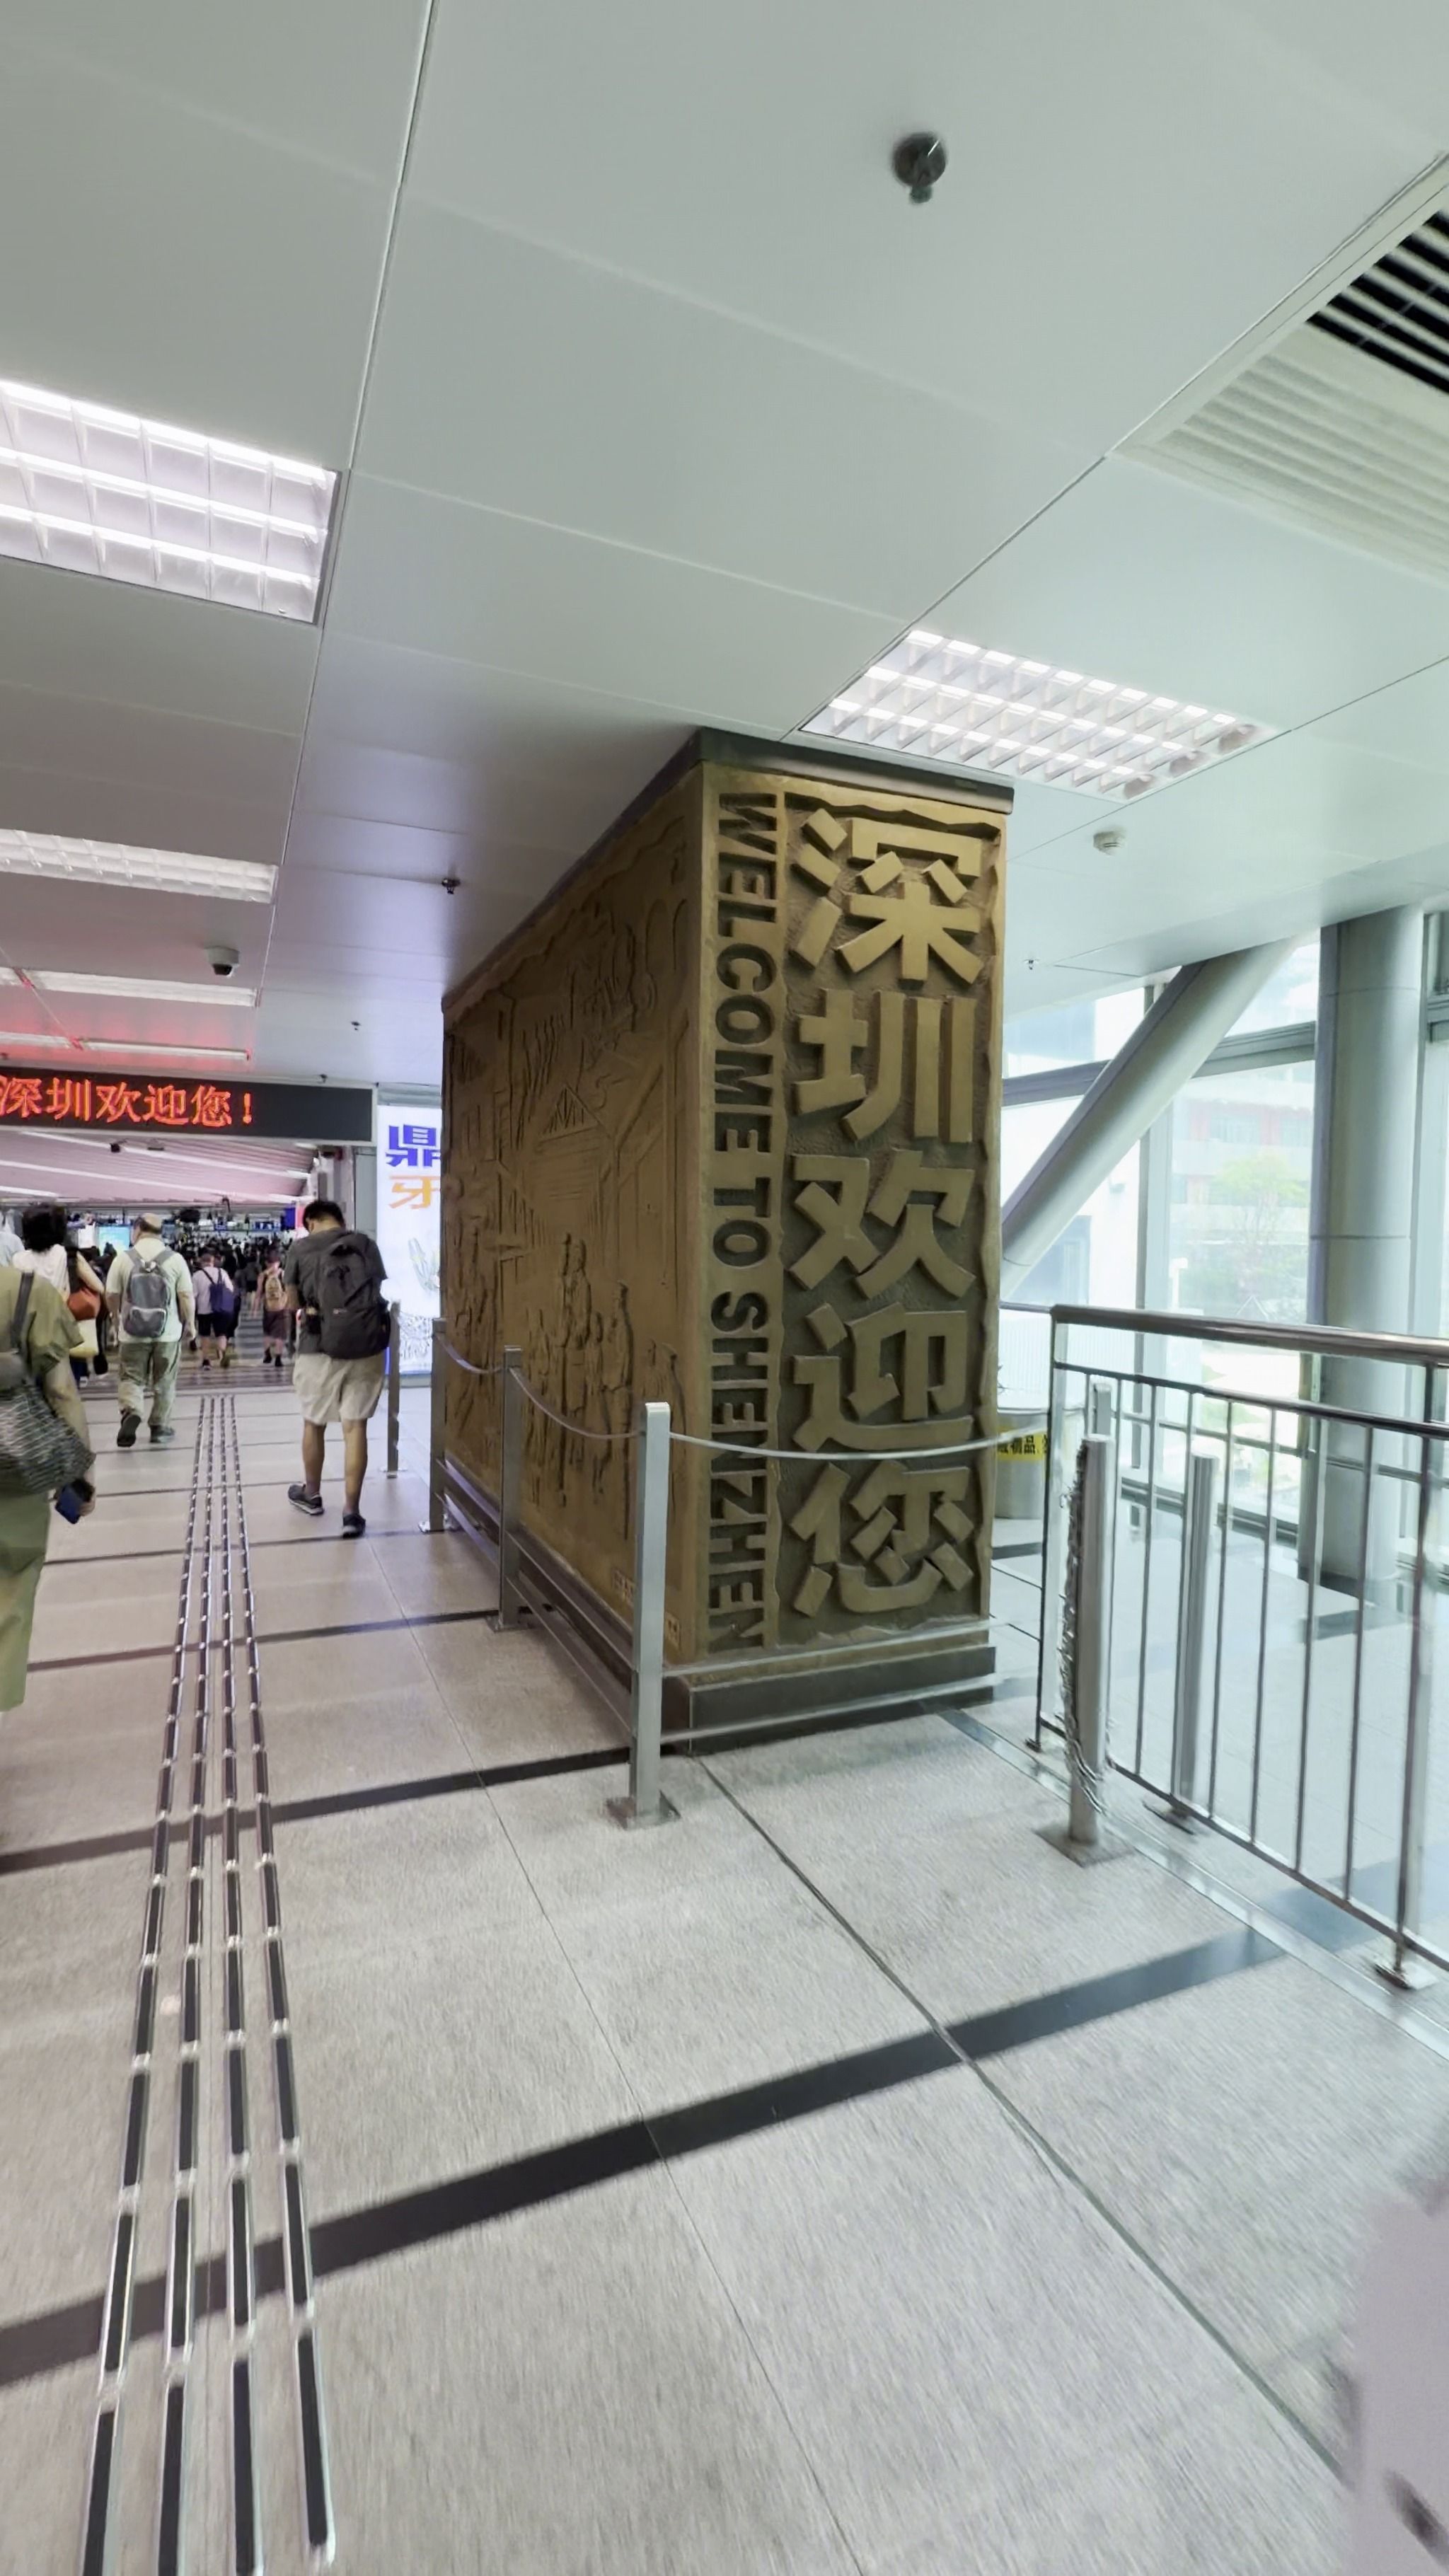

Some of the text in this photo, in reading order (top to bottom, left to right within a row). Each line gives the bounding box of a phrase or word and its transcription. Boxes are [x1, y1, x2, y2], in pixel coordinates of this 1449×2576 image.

[710, 792, 778, 1651] WELCOME TO SHENZHEN
[791, 808, 984, 1618] 深圳欢迎您
